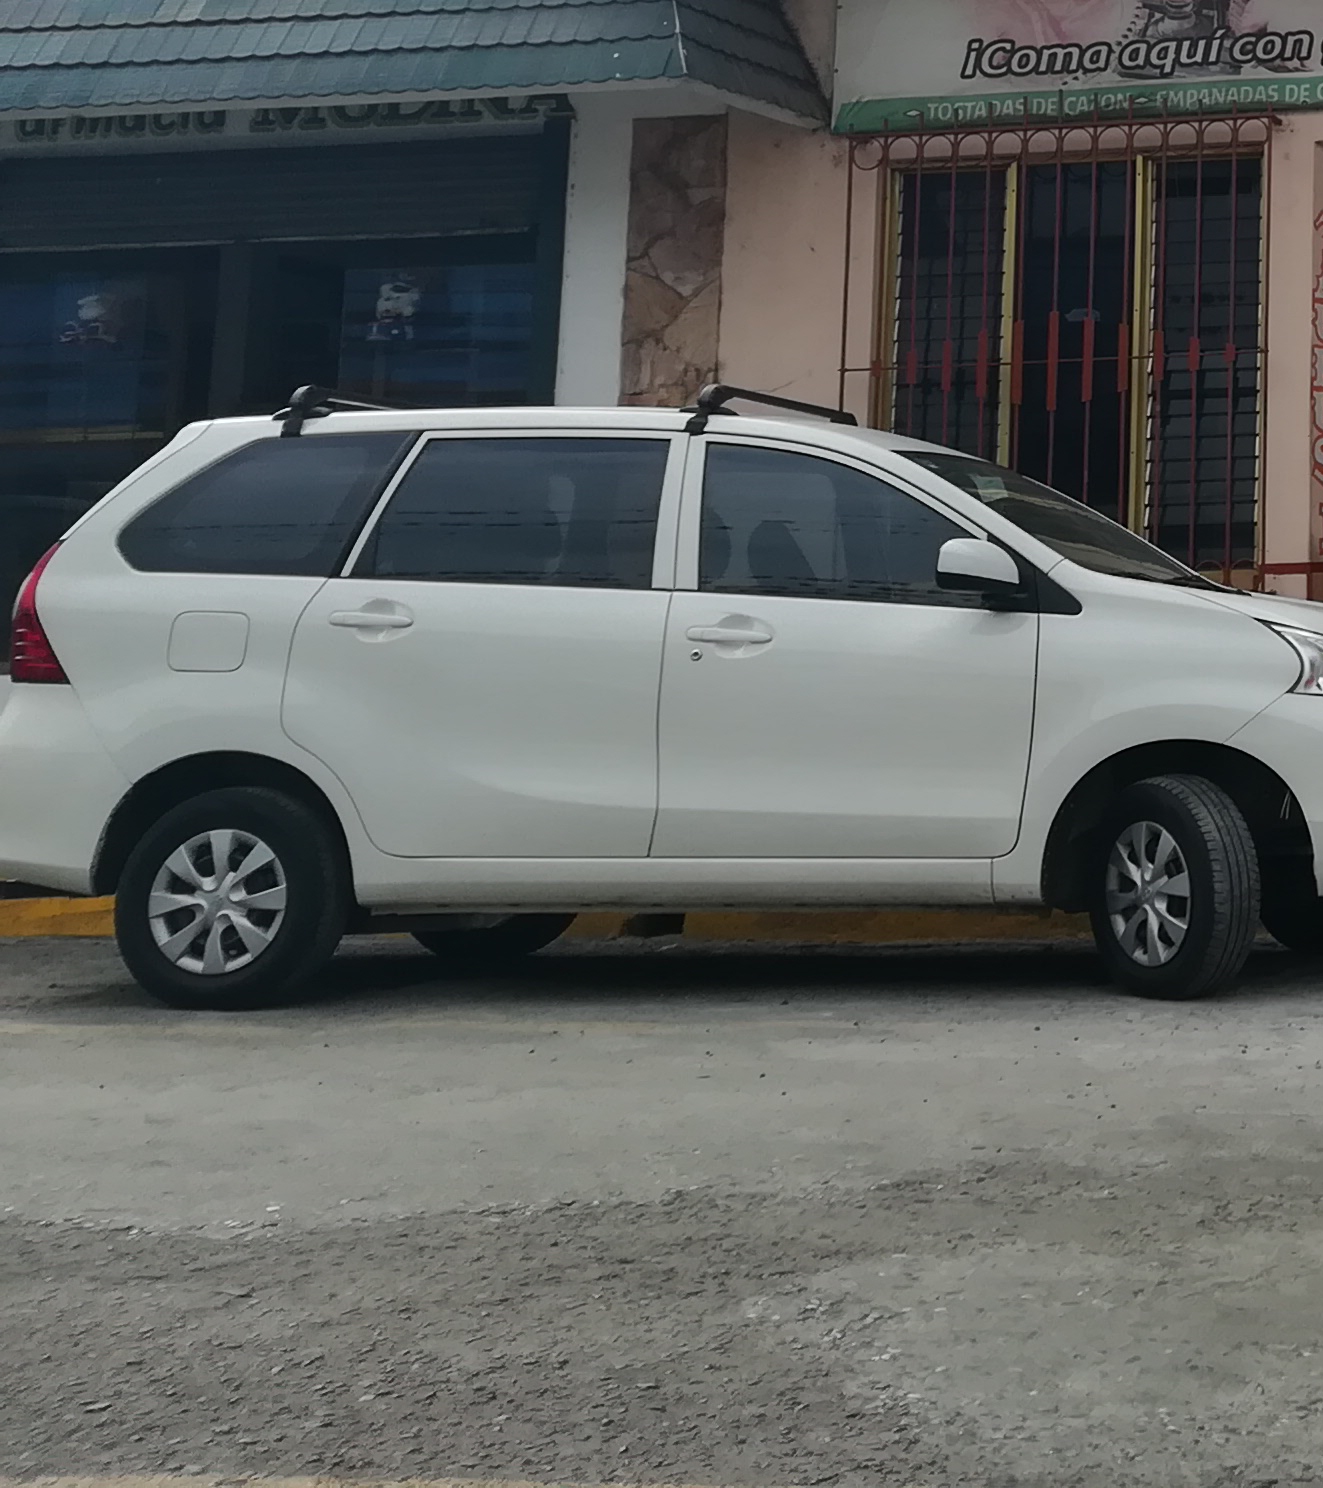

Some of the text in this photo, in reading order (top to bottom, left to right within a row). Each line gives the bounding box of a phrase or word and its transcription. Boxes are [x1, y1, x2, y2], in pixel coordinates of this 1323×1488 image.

[961, 37, 1114, 80] ¡Coma
[1118, 27, 1231, 79] aquí
[1230, 28, 1314, 65] con
[1031, 95, 1058, 117] DE
[1156, 84, 1279, 111] EMPANADAS
[1284, 83, 1311, 106] DE
